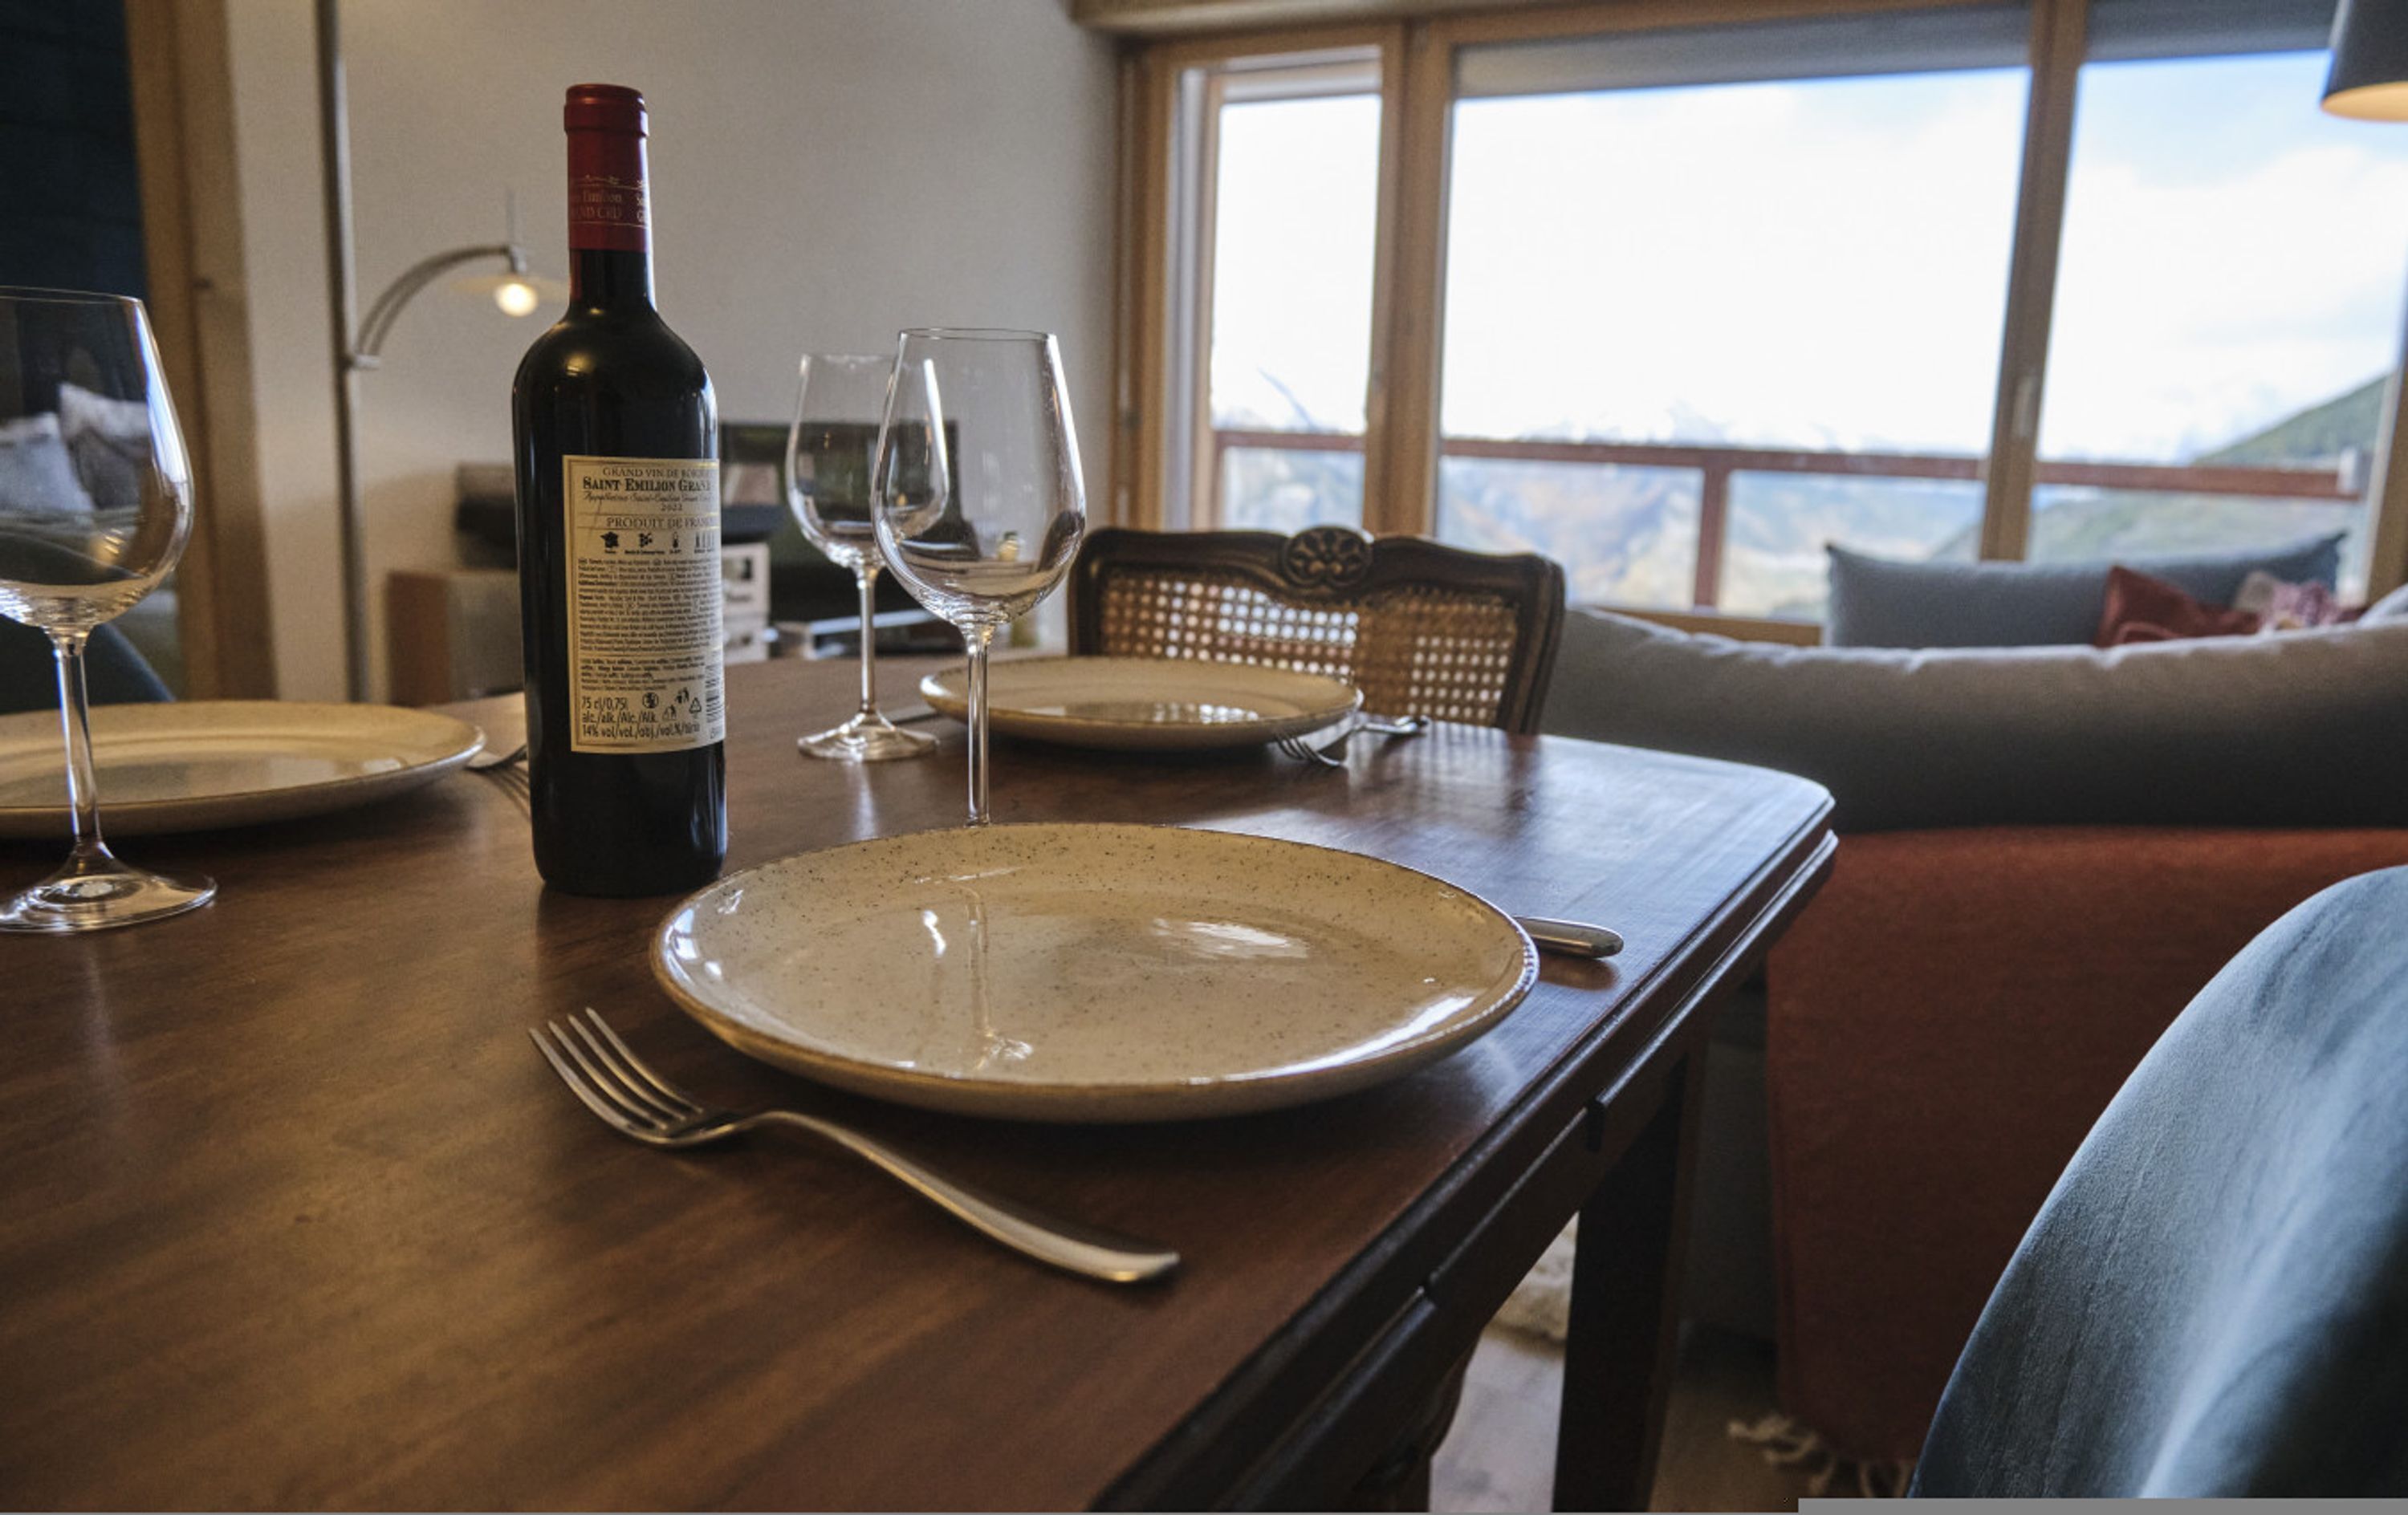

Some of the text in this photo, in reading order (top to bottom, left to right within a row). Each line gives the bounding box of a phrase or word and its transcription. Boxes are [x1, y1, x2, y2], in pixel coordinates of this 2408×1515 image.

[603, 467, 643, 477] GRAND
[645, 469, 663, 477] VIN
[667, 469, 678, 478] DE
[607, 517, 664, 528] PRODUIT
[667, 518, 682, 529] DE
[583, 724, 599, 737] 14%
